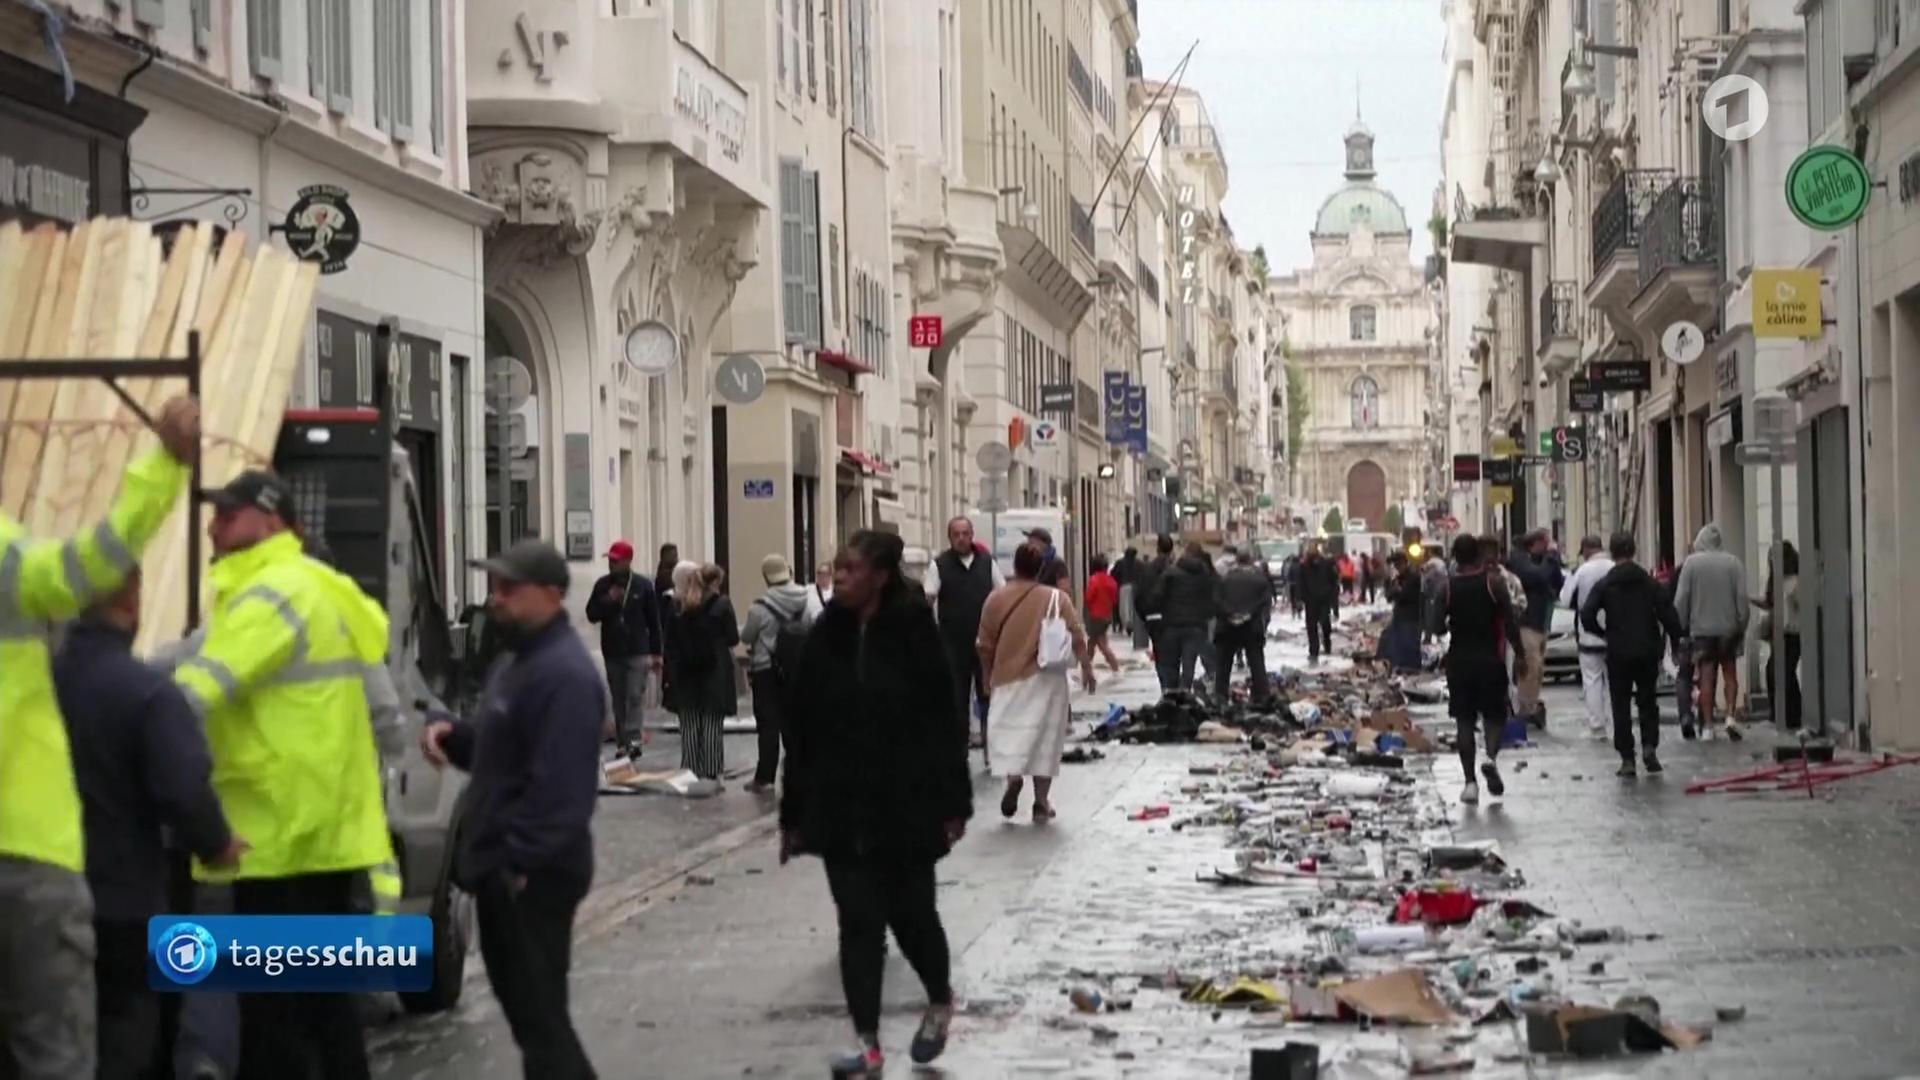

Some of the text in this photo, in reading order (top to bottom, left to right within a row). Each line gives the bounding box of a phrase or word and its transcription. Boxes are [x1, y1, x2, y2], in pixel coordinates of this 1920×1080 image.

[1806, 173, 1856, 213] VAPOTEUR
[1812, 158, 1841, 187] PETIT
[1179, 185, 1196, 305] HOTEL
[1766, 300, 1807, 312] la mie
[1110, 371, 1125, 416] LCL
[1128, 384, 1142, 430] LCL
